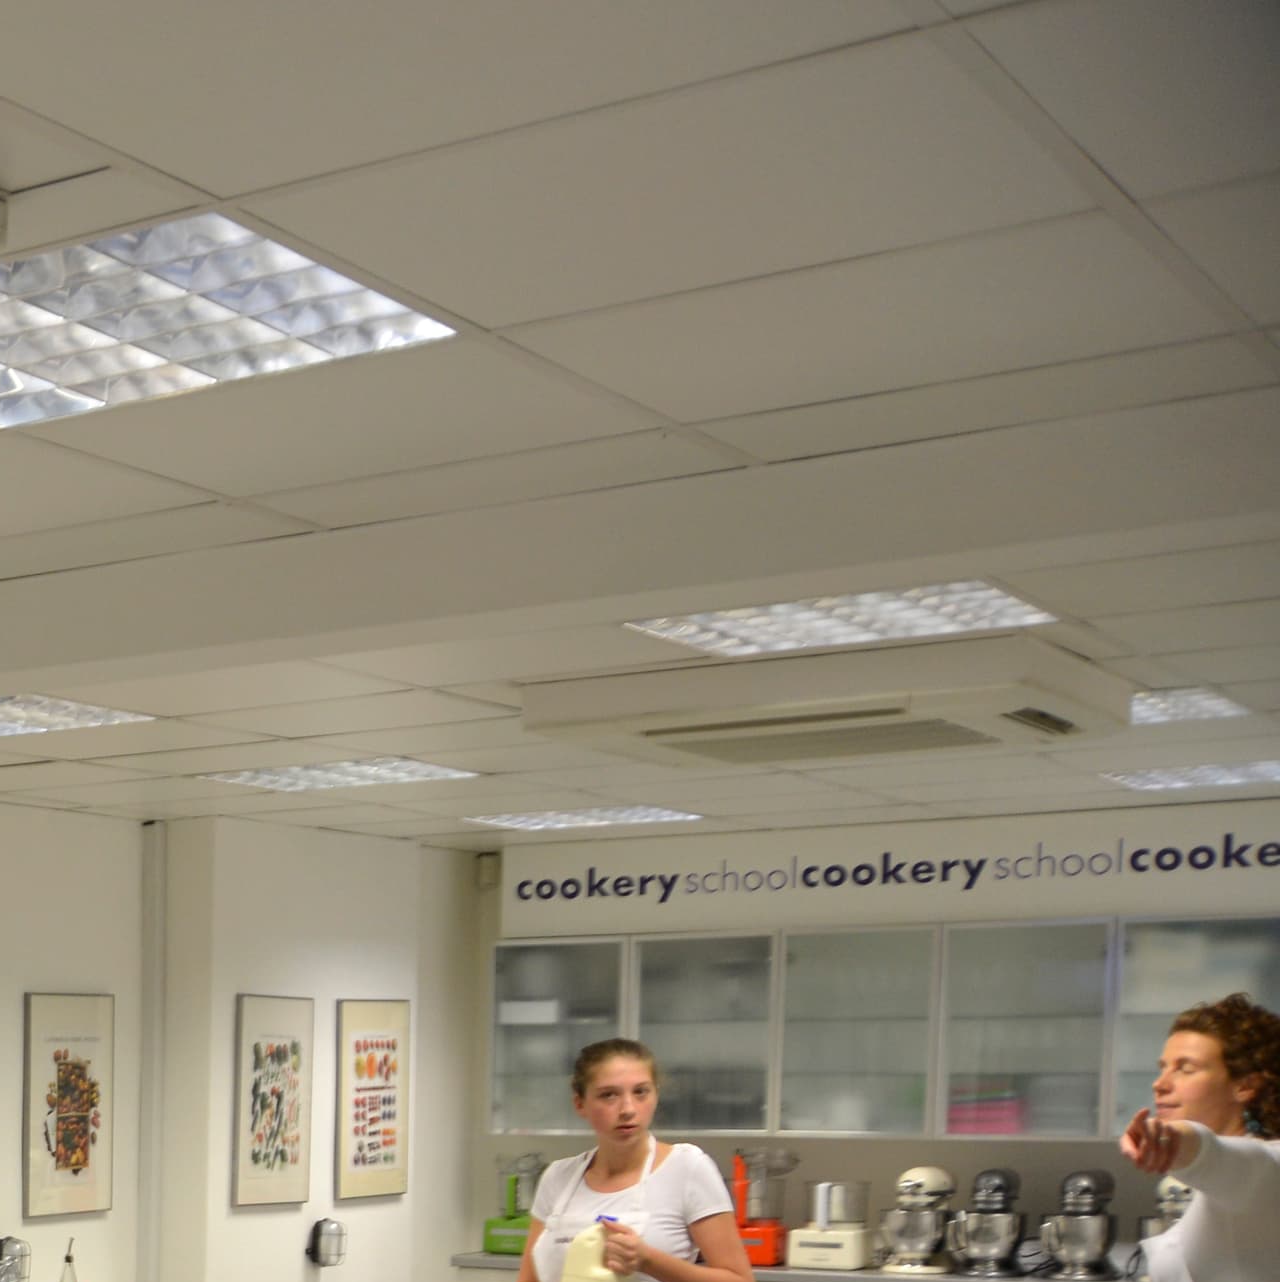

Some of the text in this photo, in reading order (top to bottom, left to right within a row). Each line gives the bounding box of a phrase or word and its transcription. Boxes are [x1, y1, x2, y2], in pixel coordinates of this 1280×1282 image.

[516, 866, 679, 904] cookery
[685, 858, 797, 894] school
[801, 851, 987, 890] cookery
[994, 838, 1124, 880] school
